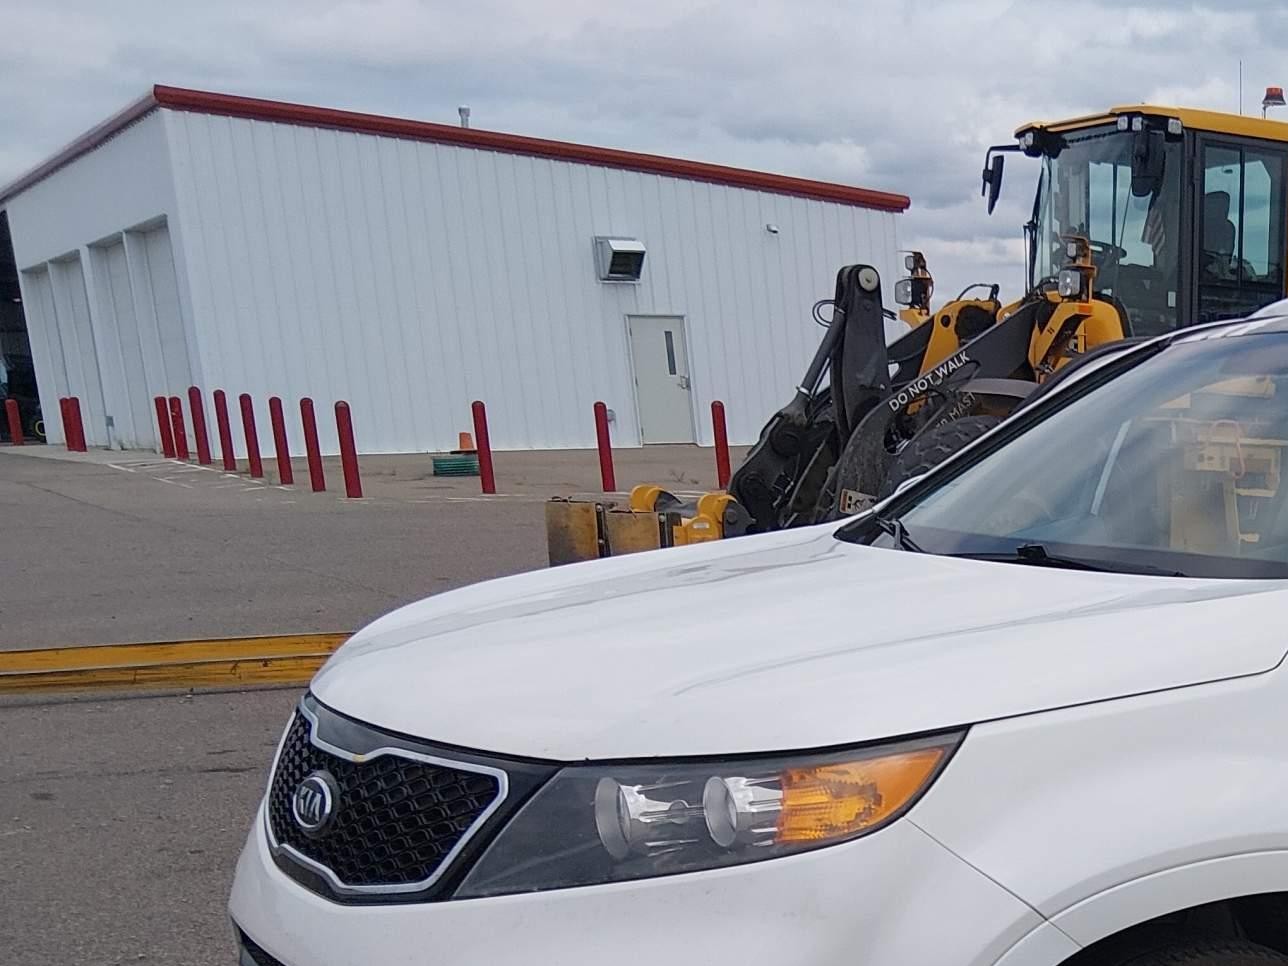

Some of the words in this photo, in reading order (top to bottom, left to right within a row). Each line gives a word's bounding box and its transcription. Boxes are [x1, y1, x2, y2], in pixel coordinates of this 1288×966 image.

[888, 392, 908, 412] DO
[908, 373, 936, 398] NOT
[935, 350, 971, 379] WALK
